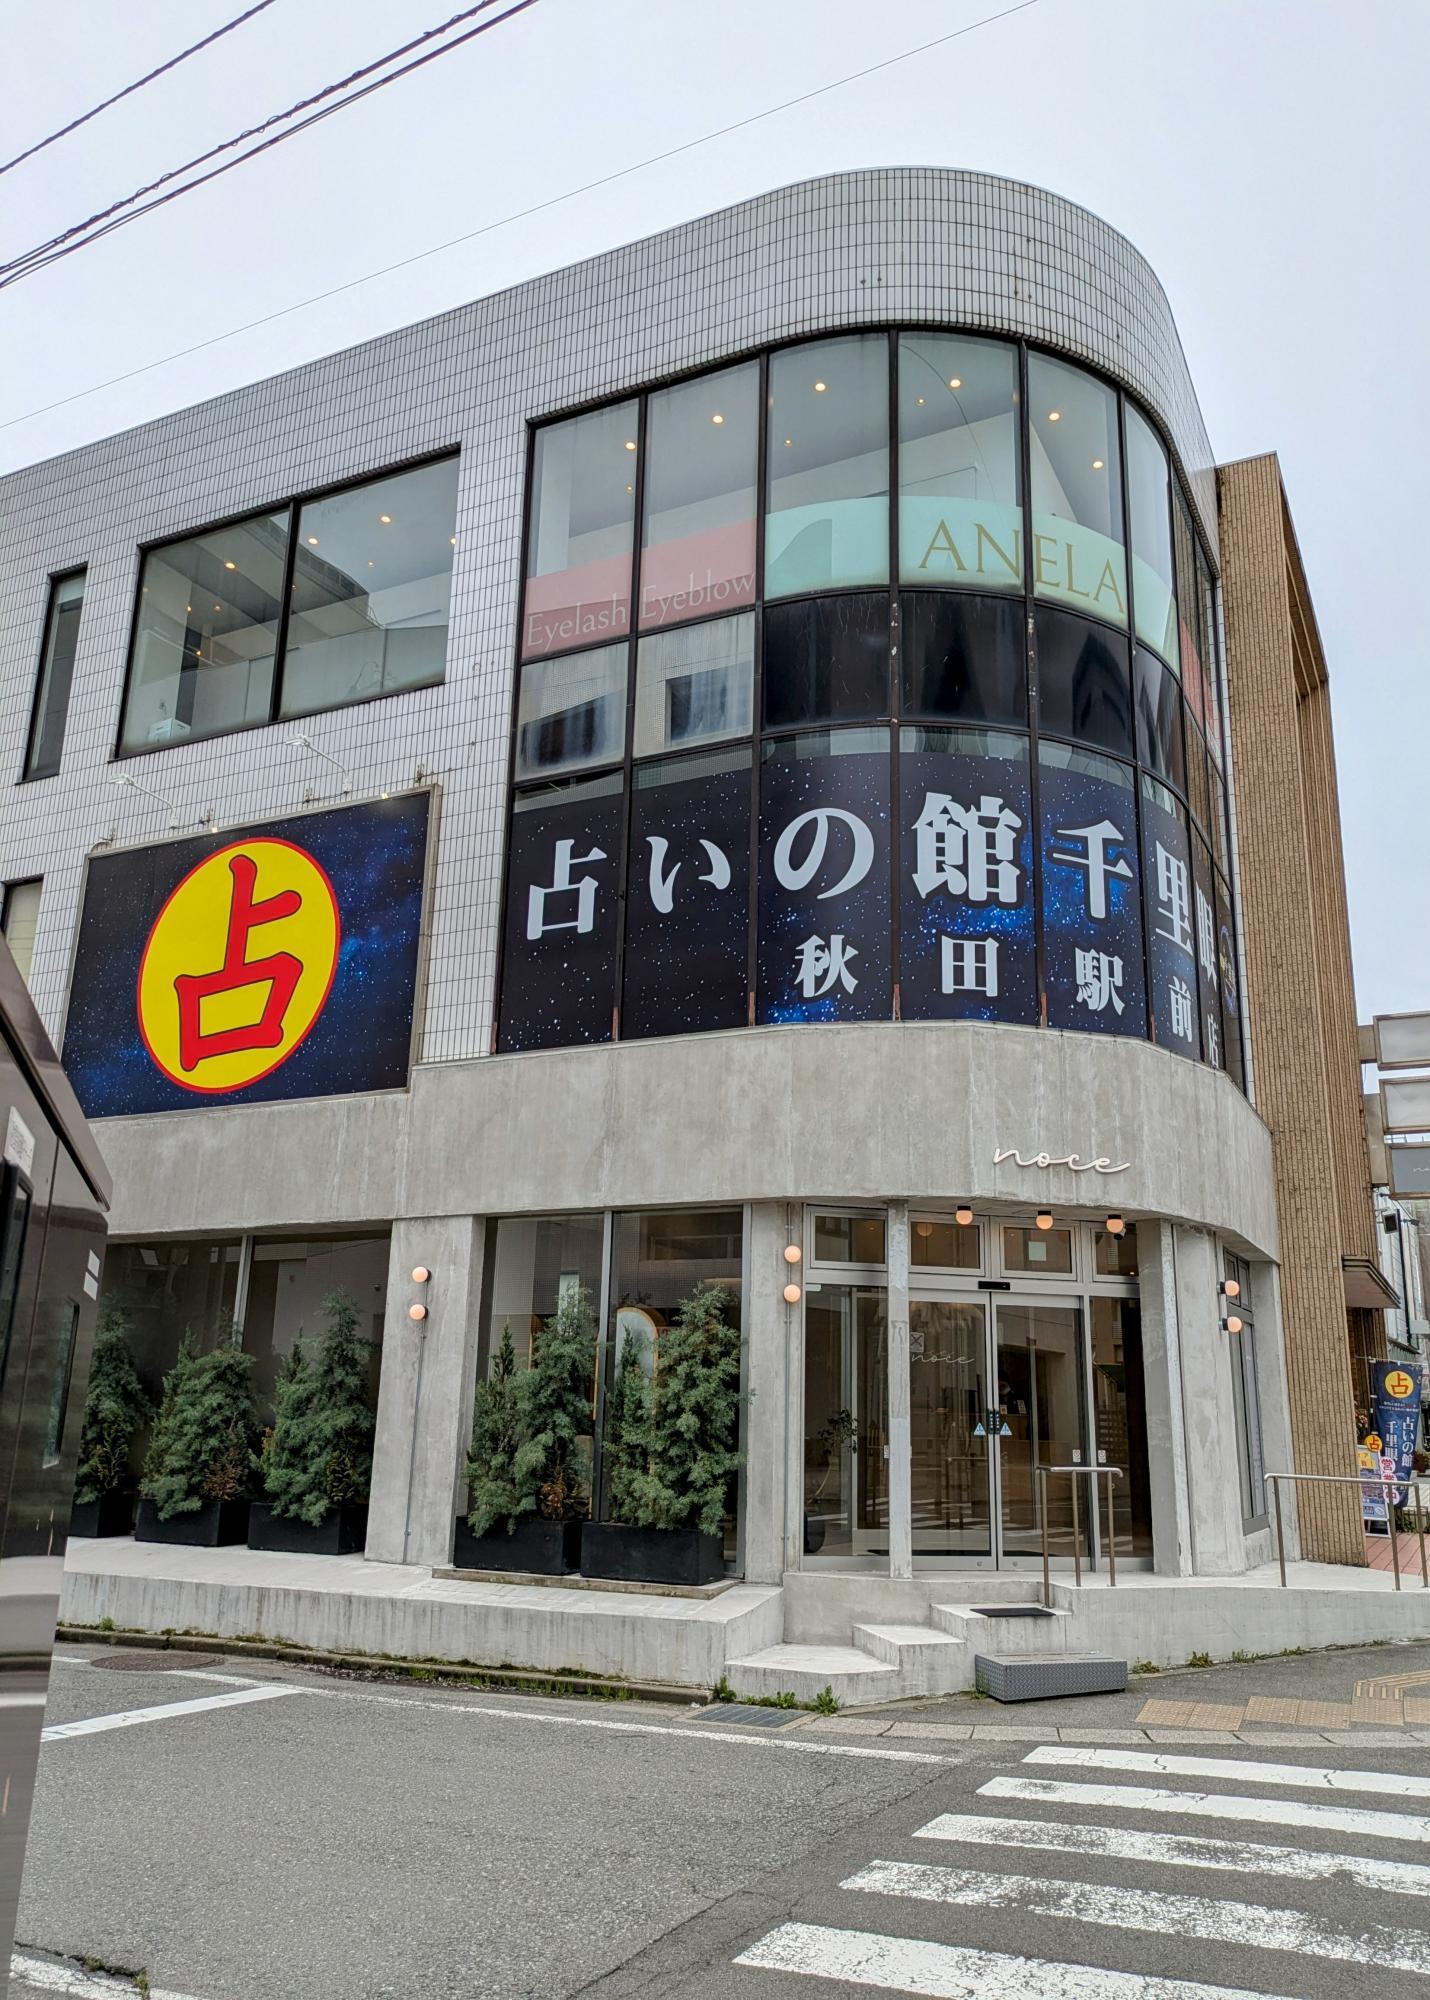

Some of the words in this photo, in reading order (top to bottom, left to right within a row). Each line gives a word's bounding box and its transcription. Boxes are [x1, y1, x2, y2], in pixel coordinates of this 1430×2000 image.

[527, 592, 627, 652] Eyelash
[641, 568, 756, 623] Eyeblow
[918, 519, 1125, 614] ANELA
[173, 853, 304, 1072] 占
[795, 934, 1220, 1069] 秋田駅前店
[992, 1146, 1131, 1174] noce
[1390, 1371, 1409, 1395] 占
